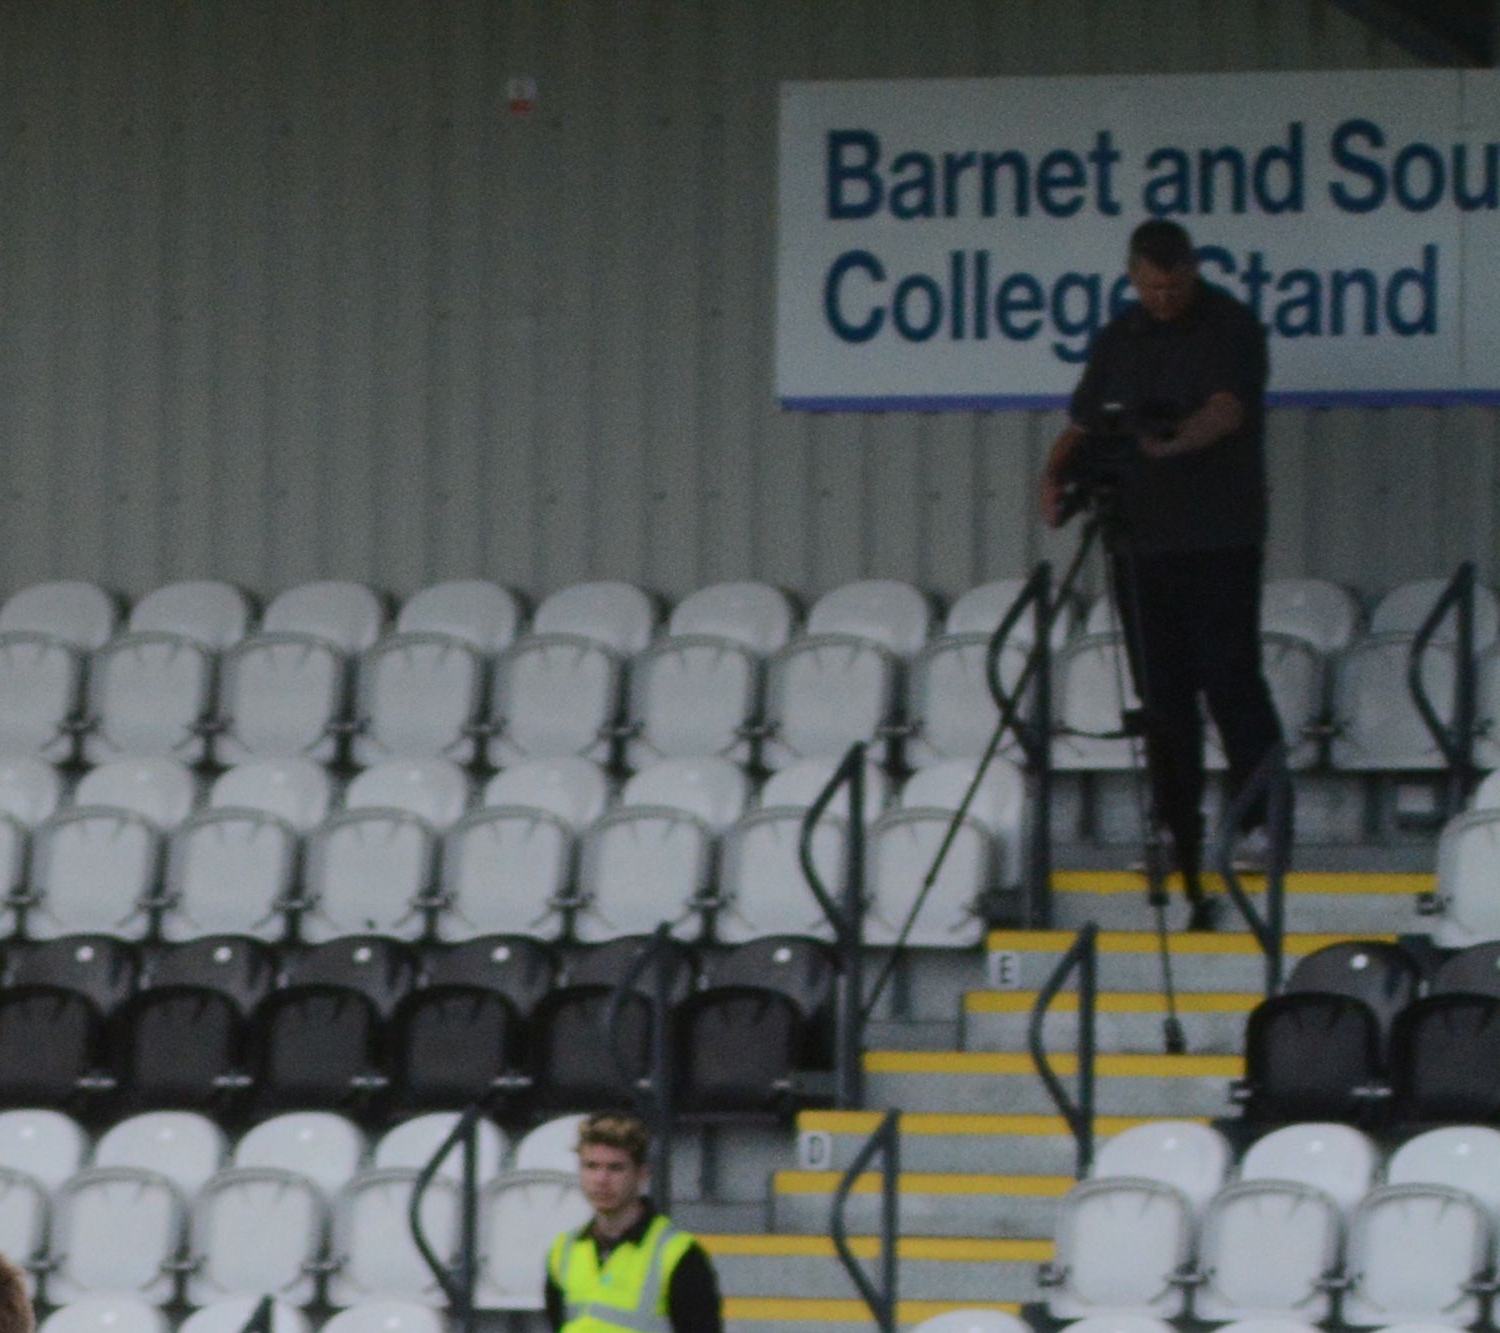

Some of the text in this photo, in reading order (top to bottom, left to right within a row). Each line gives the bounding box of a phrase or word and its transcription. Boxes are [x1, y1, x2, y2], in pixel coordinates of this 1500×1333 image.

[825, 117, 1500, 221] Barnet and Sou
